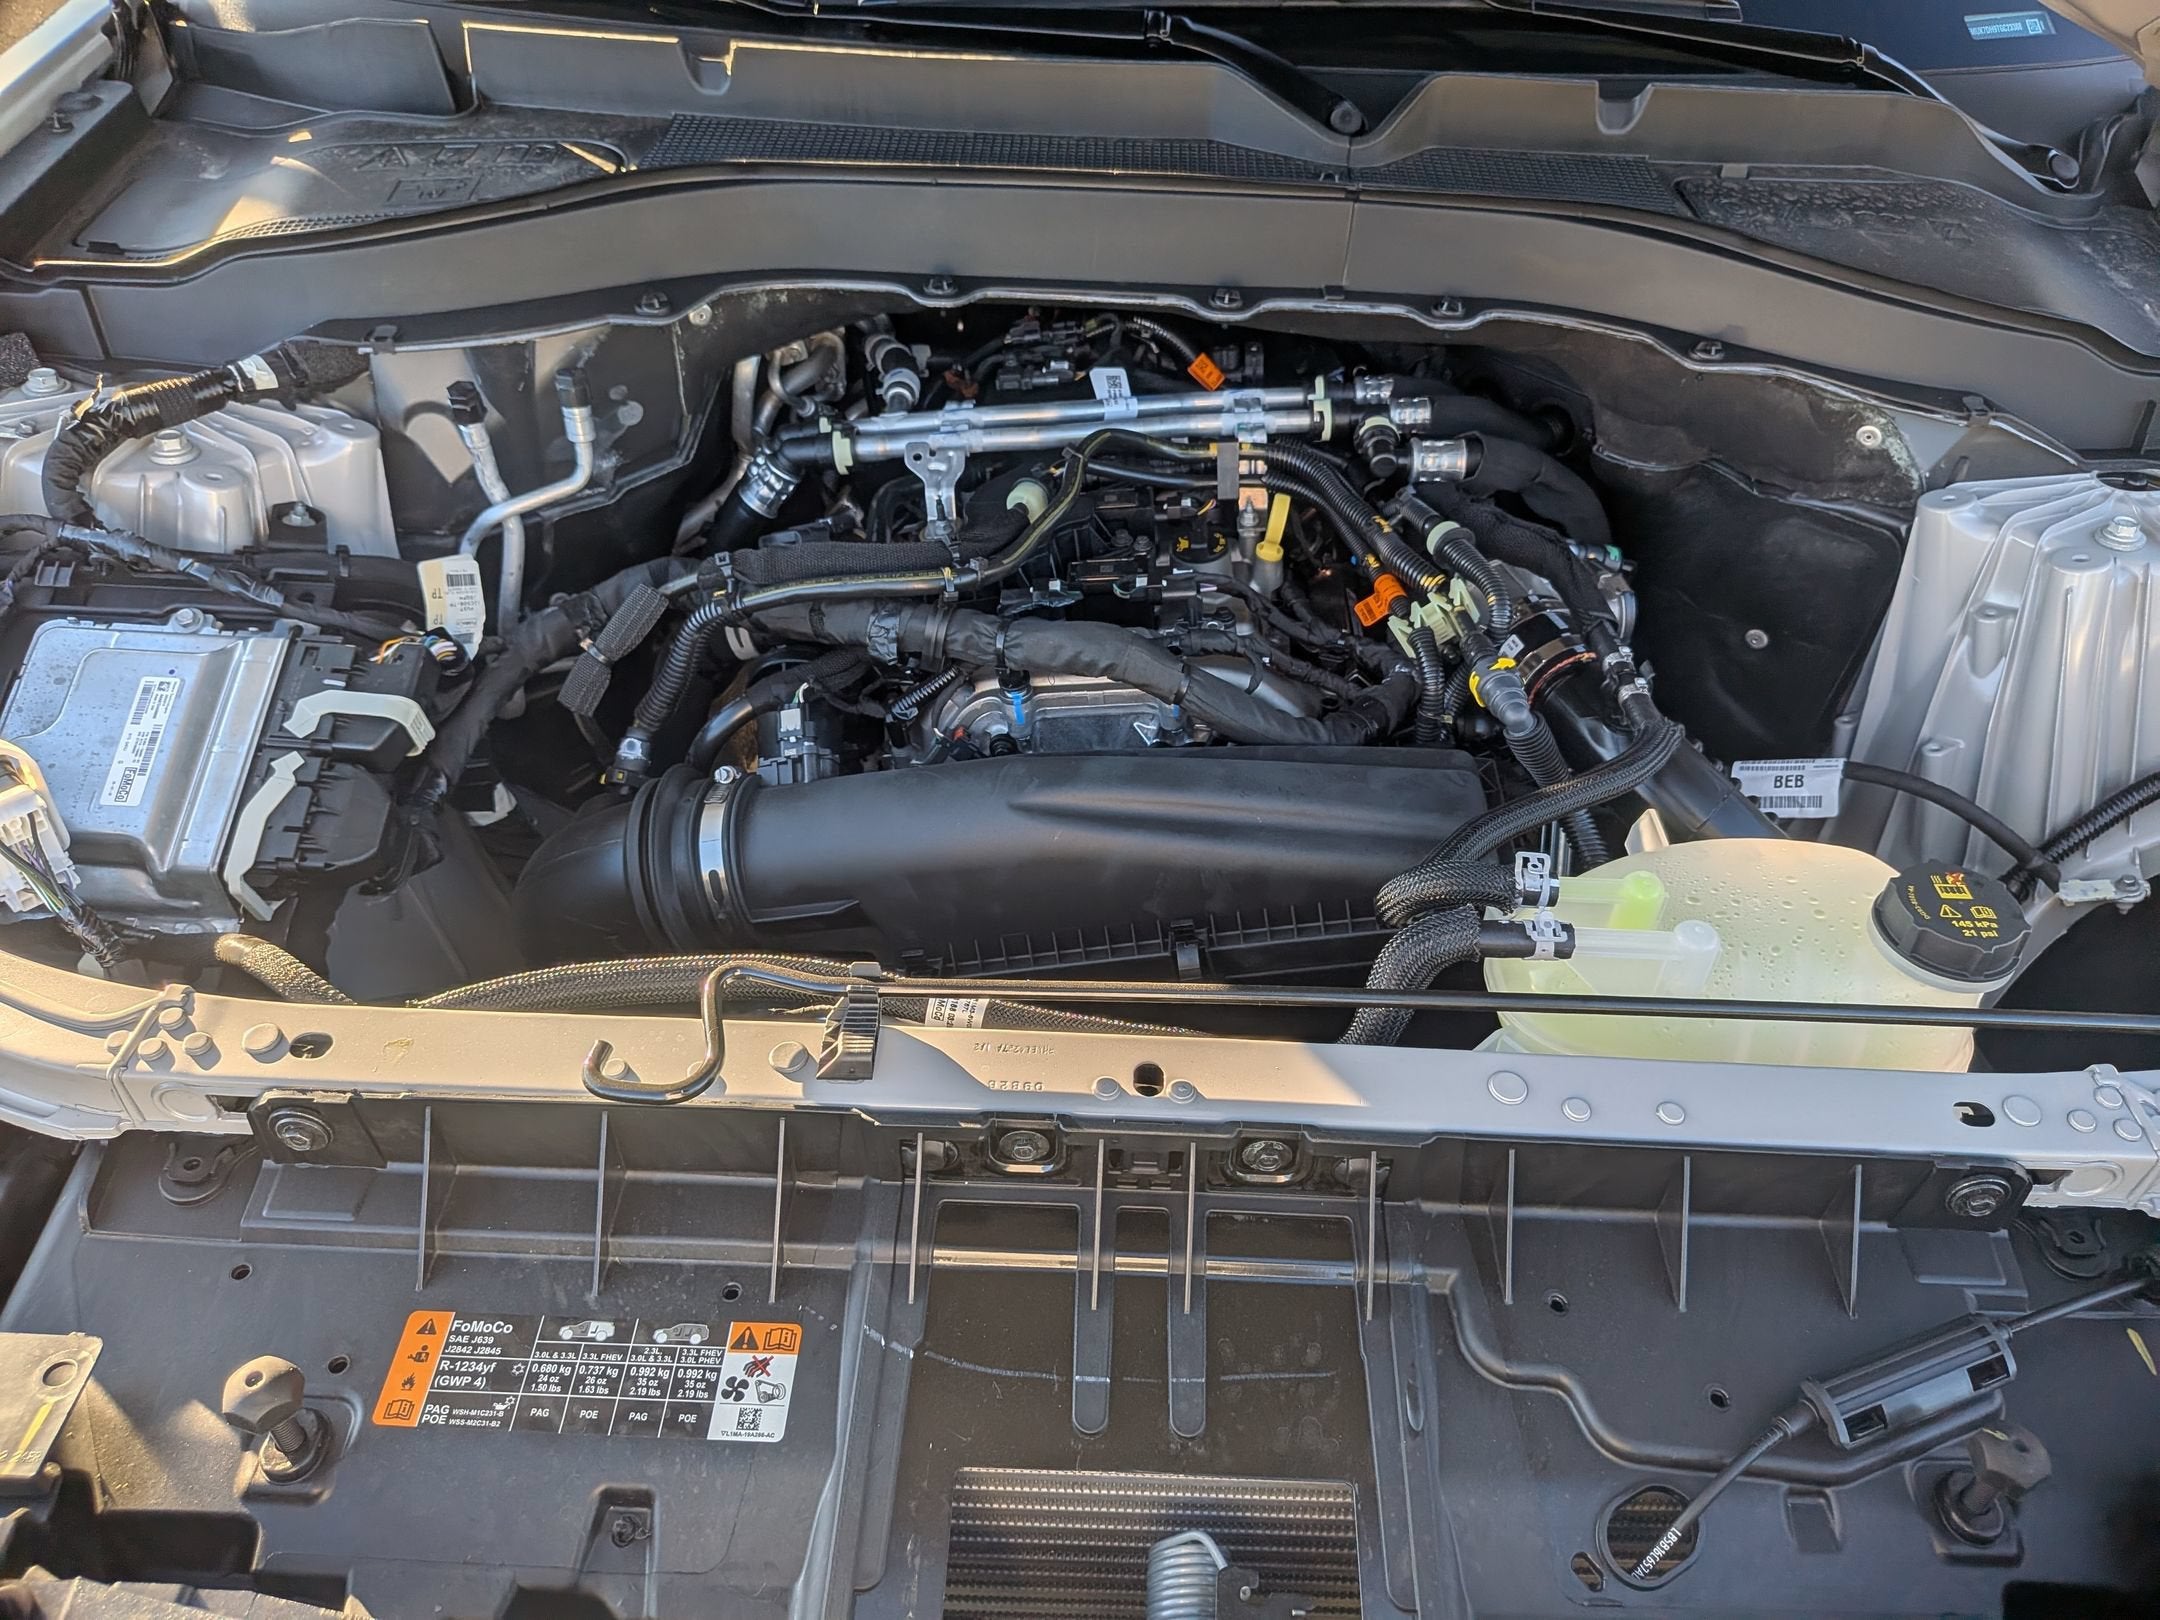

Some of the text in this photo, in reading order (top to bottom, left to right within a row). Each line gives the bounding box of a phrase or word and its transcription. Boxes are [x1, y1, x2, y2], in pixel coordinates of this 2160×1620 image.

[117, 768, 137, 801] FoMoCo
[1774, 774, 1804, 788] BEB
[1951, 920, 1999, 929] 145 kPa
[1962, 929, 1999, 938] 21 psi
[935, 998, 946, 1020] MoCo
[452, 1320, 513, 1333] FoMoCo
[449, 1335, 494, 1344] SAE J639
[445, 1345, 502, 1355] J2842 J2845
[682, 1348, 723, 1357] 3.3L FHEV
[630, 1354, 647, 1362] 3.0L
[680, 1356, 697, 1364] 3.0L
[439, 1360, 497, 1374] R-1234yf
[532, 1363, 572, 1376] 0.680 kg
[579, 1365, 619, 1378] 0.737 kg
[630, 1366, 670, 1379] 0.992 kg
[677, 1368, 718, 1381] 0.992 kg
[434, 1375, 486, 1390] (GWP 4)
[538, 1374, 548, 1382] 24
[585, 1376, 596, 1384] 26
[637, 1378, 647, 1386] 35
[531, 1384, 561, 1393] 1.50 lbs
[685, 1380, 706, 1389] 35 oz
[579, 1385, 609, 1394] 1.63 lbs
[629, 1387, 661, 1396] 2.19 lbs
[677, 1389, 709, 1398] 2.19 lbs
[425, 1404, 450, 1414] PAG
[530, 1408, 550, 1417] PAG
[579, 1409, 599, 1419] POE
[628, 1412, 648, 1421] PAG
[678, 1414, 697, 1423] POE
[421, 1414, 447, 1424] POE
